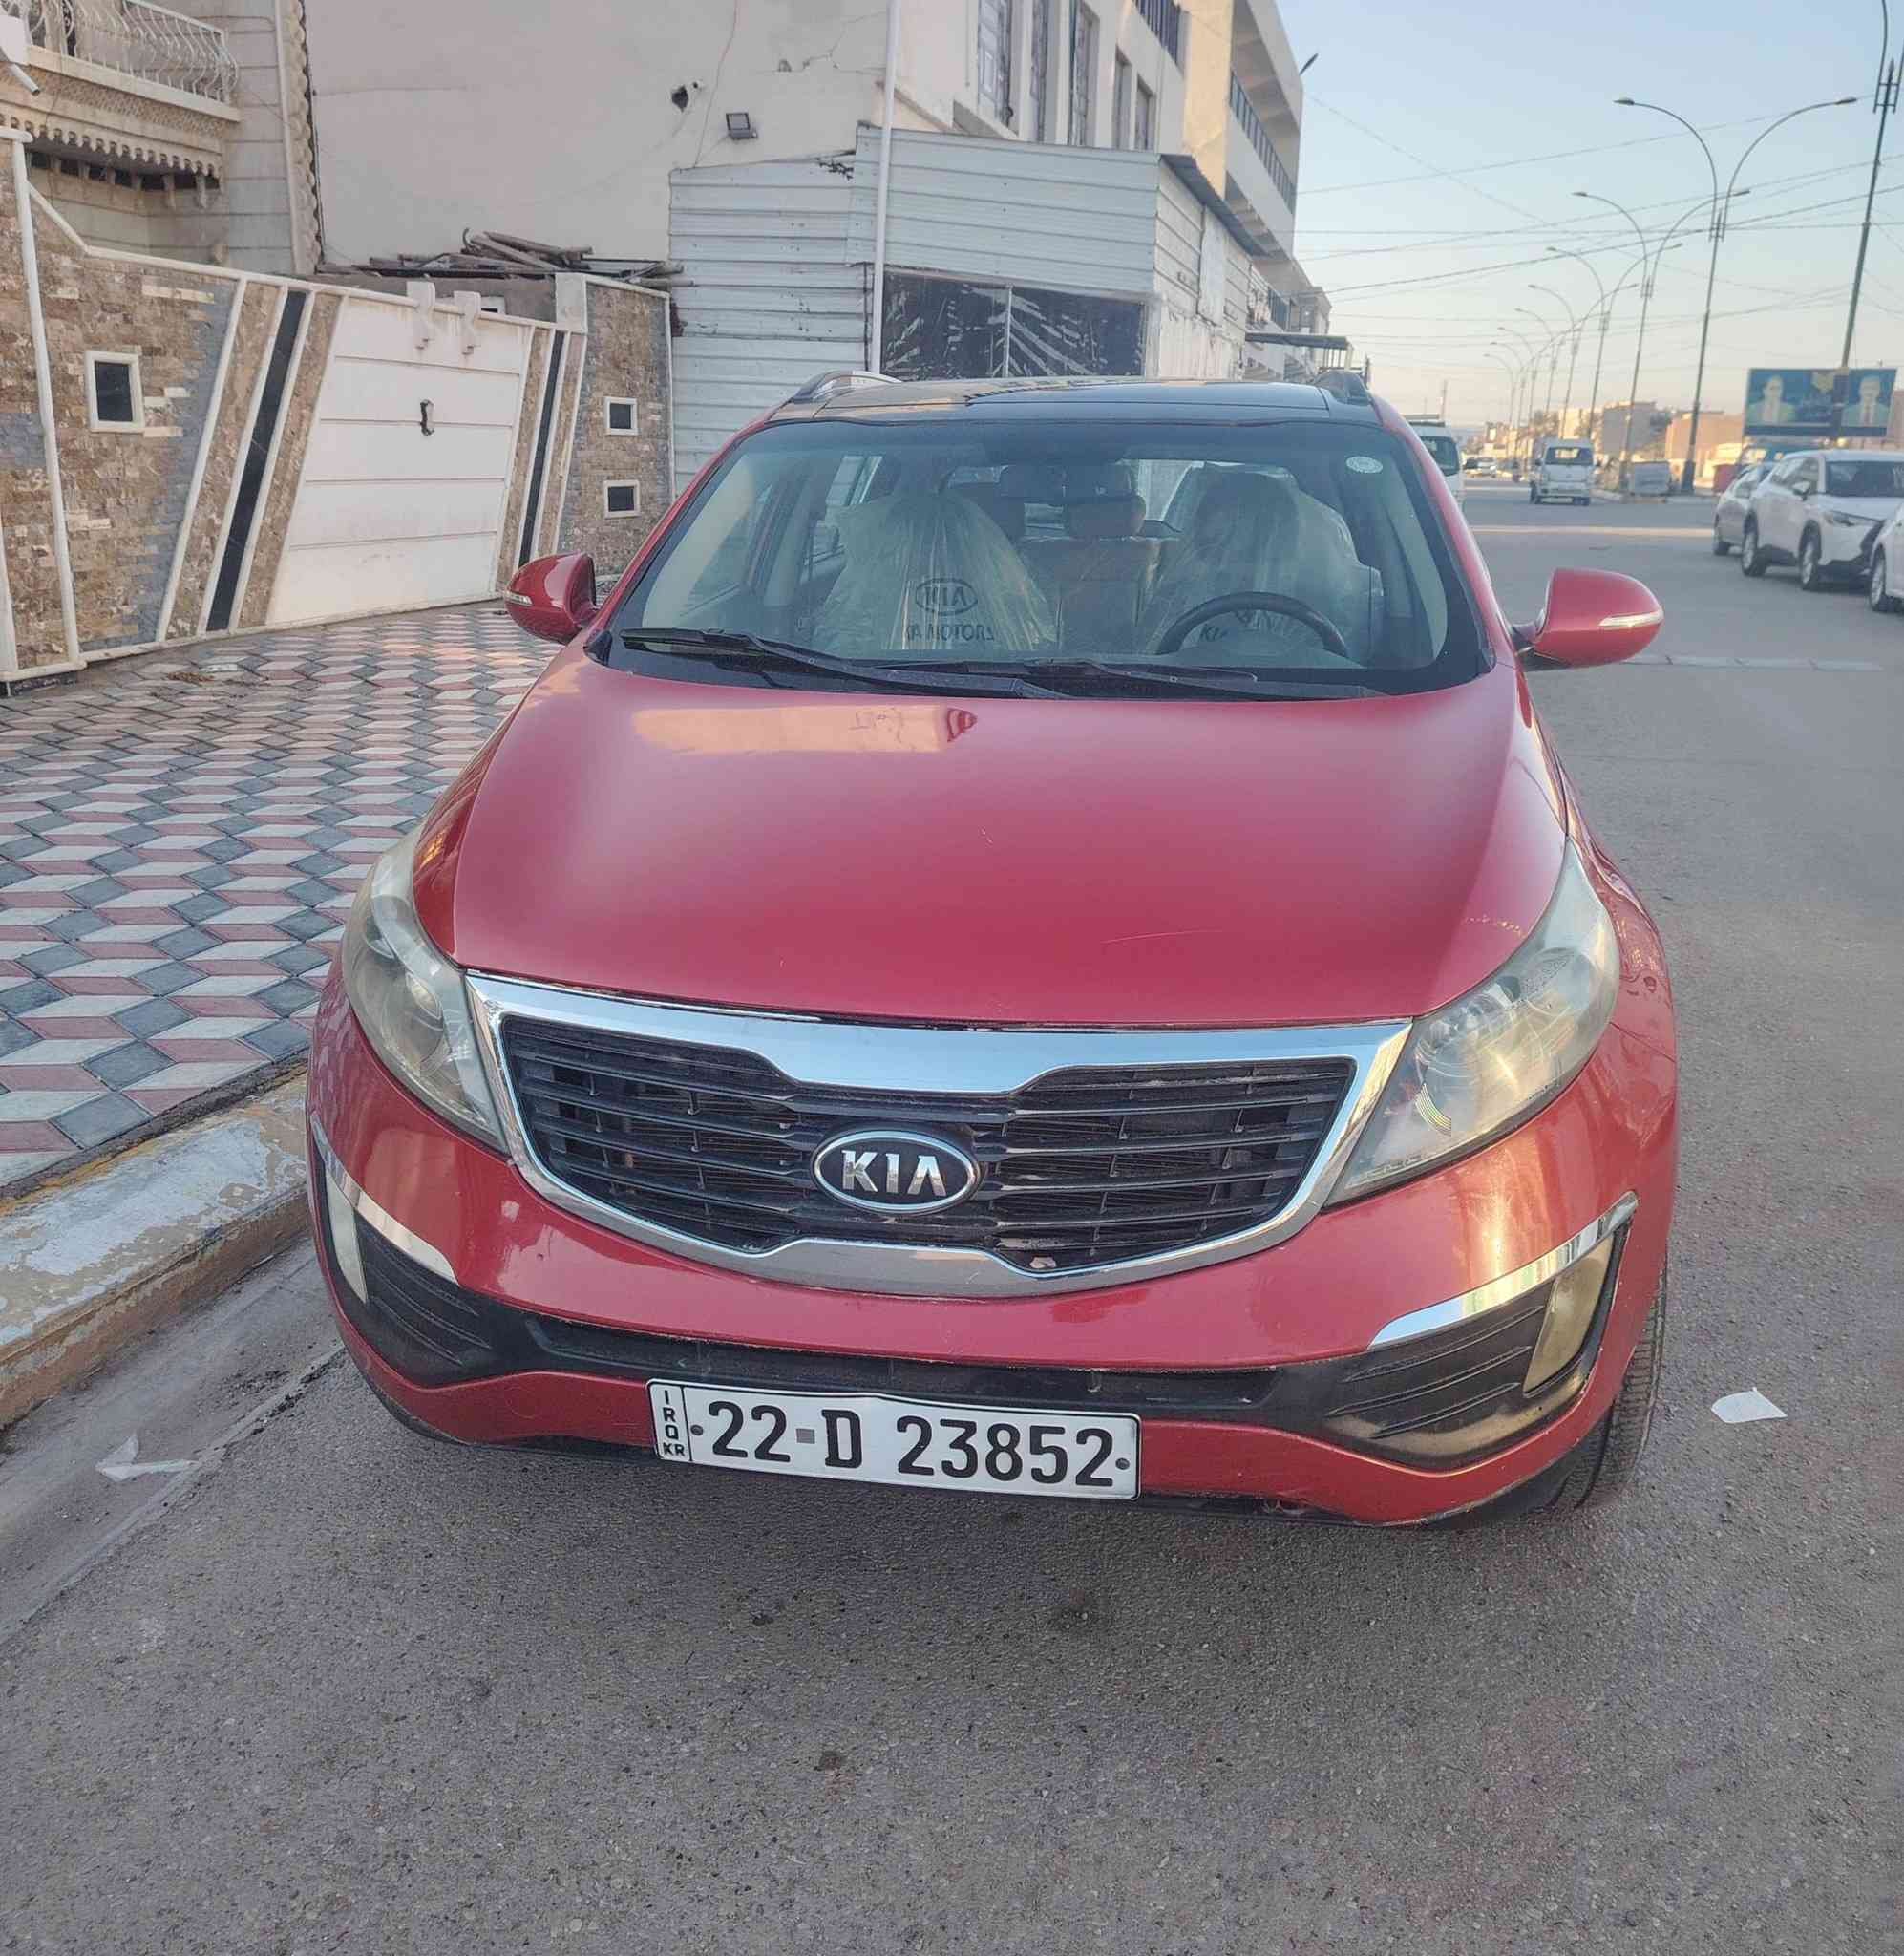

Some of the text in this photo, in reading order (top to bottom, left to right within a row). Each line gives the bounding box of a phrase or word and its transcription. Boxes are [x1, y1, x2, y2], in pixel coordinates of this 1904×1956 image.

[841, 1150, 946, 1197] KIA
[663, 1390, 679, 1440] IRQ
[663, 1442, 685, 1456] KR
[896, 1415, 1113, 1487] 23852
